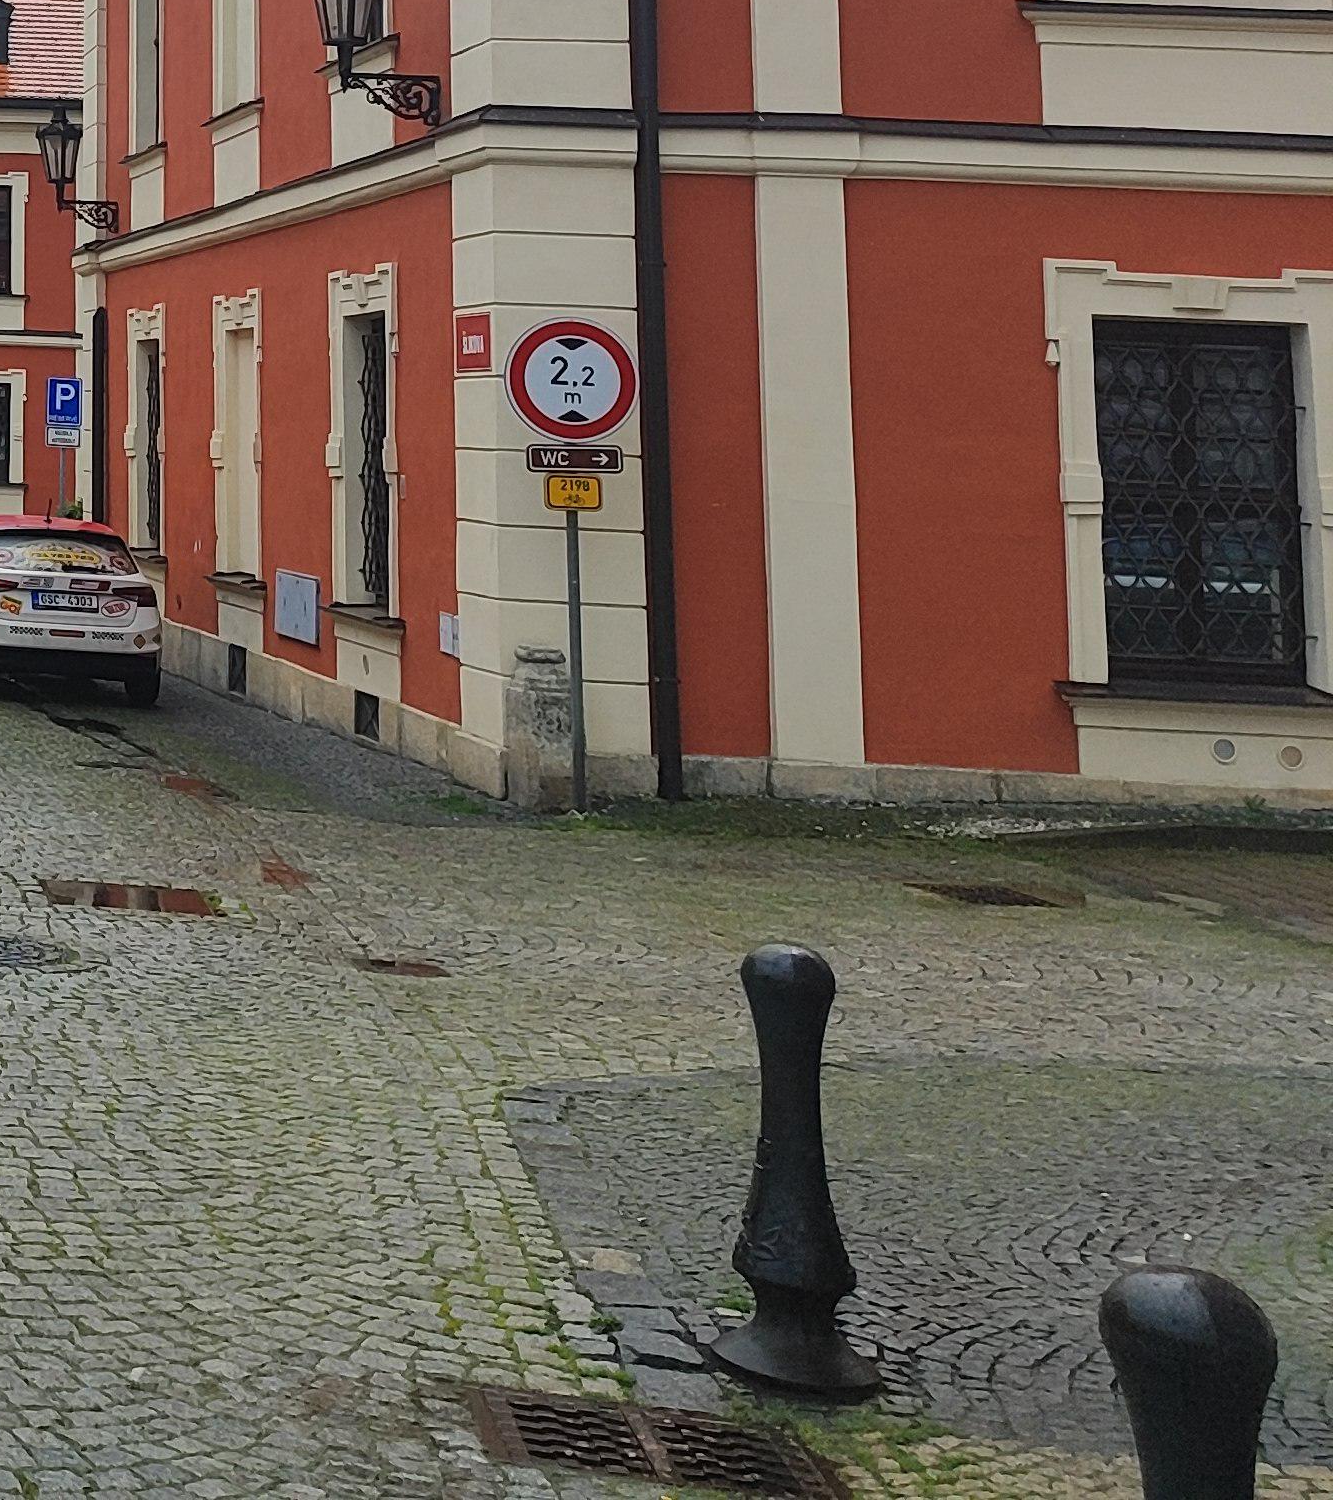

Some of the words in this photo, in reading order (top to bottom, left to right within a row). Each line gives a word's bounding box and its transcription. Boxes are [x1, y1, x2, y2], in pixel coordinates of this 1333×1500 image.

[55, 383, 76, 411] P
[564, 391, 582, 404] m
[540, 450, 570, 466] WC
[559, 479, 591, 492] 2198
